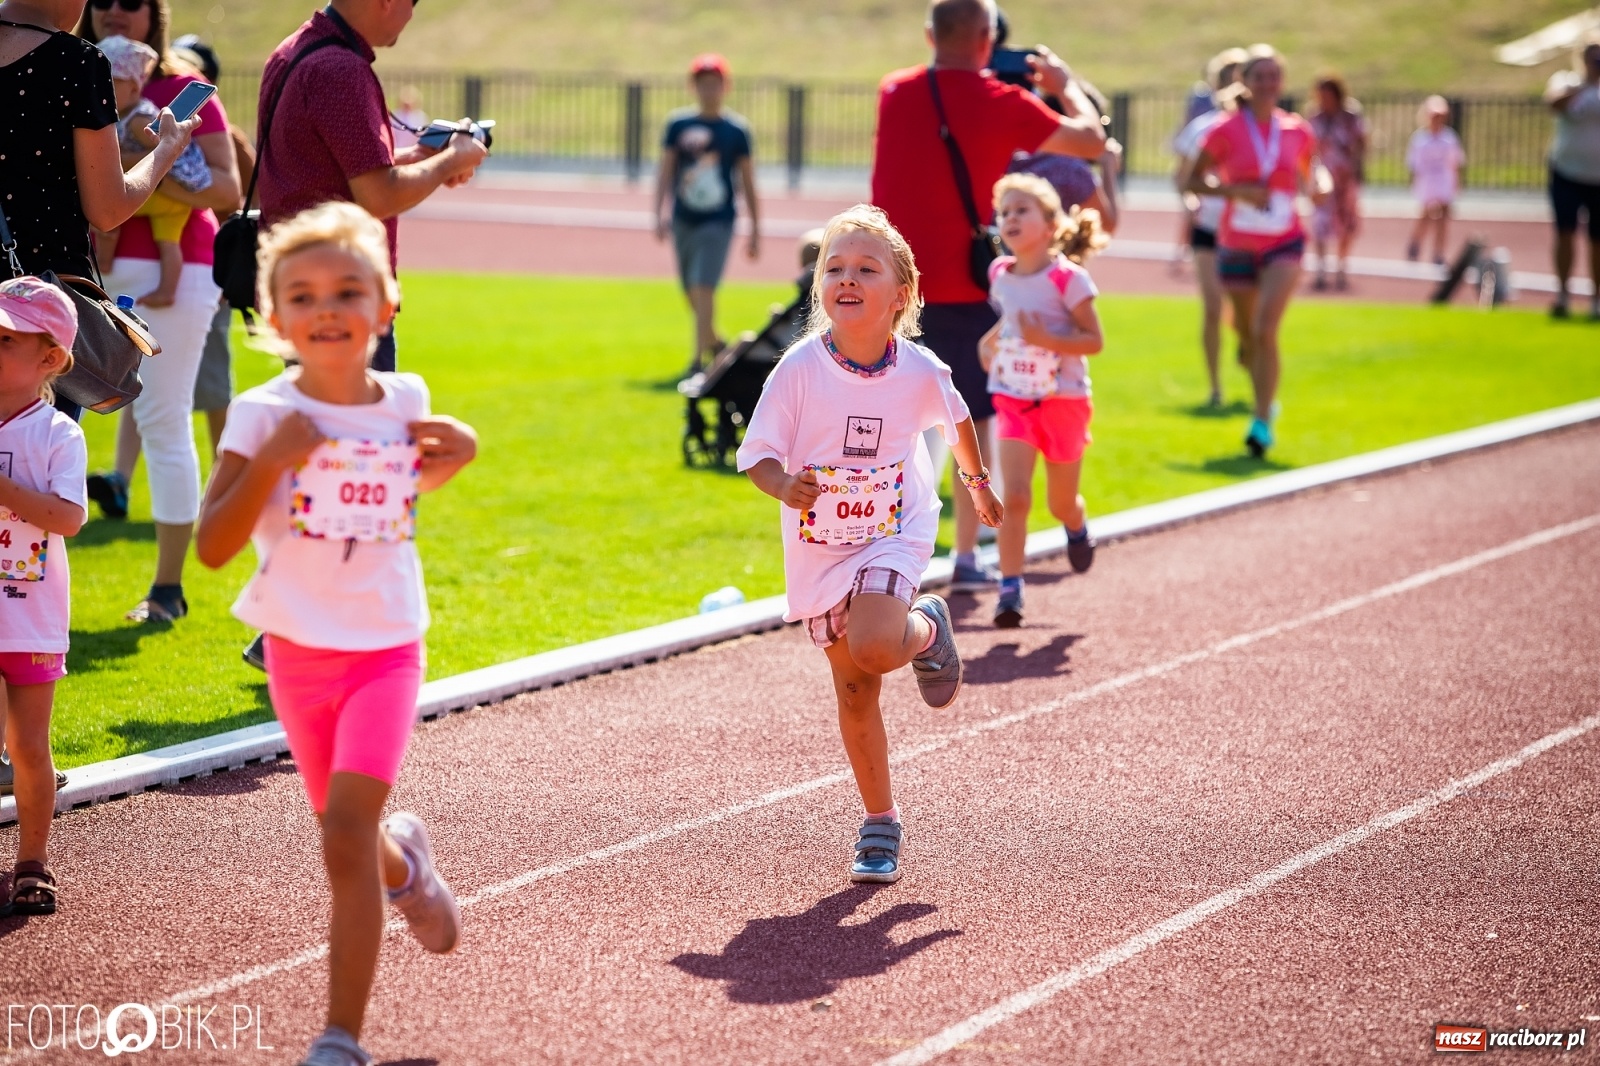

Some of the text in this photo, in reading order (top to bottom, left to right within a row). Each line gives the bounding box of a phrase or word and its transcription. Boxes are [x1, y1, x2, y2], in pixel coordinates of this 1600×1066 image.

[340, 481, 387, 505] 020
[820, 481, 889, 494] KIDS RUN
[0, 510, 27, 522] RU
[836, 500, 875, 519] 046
